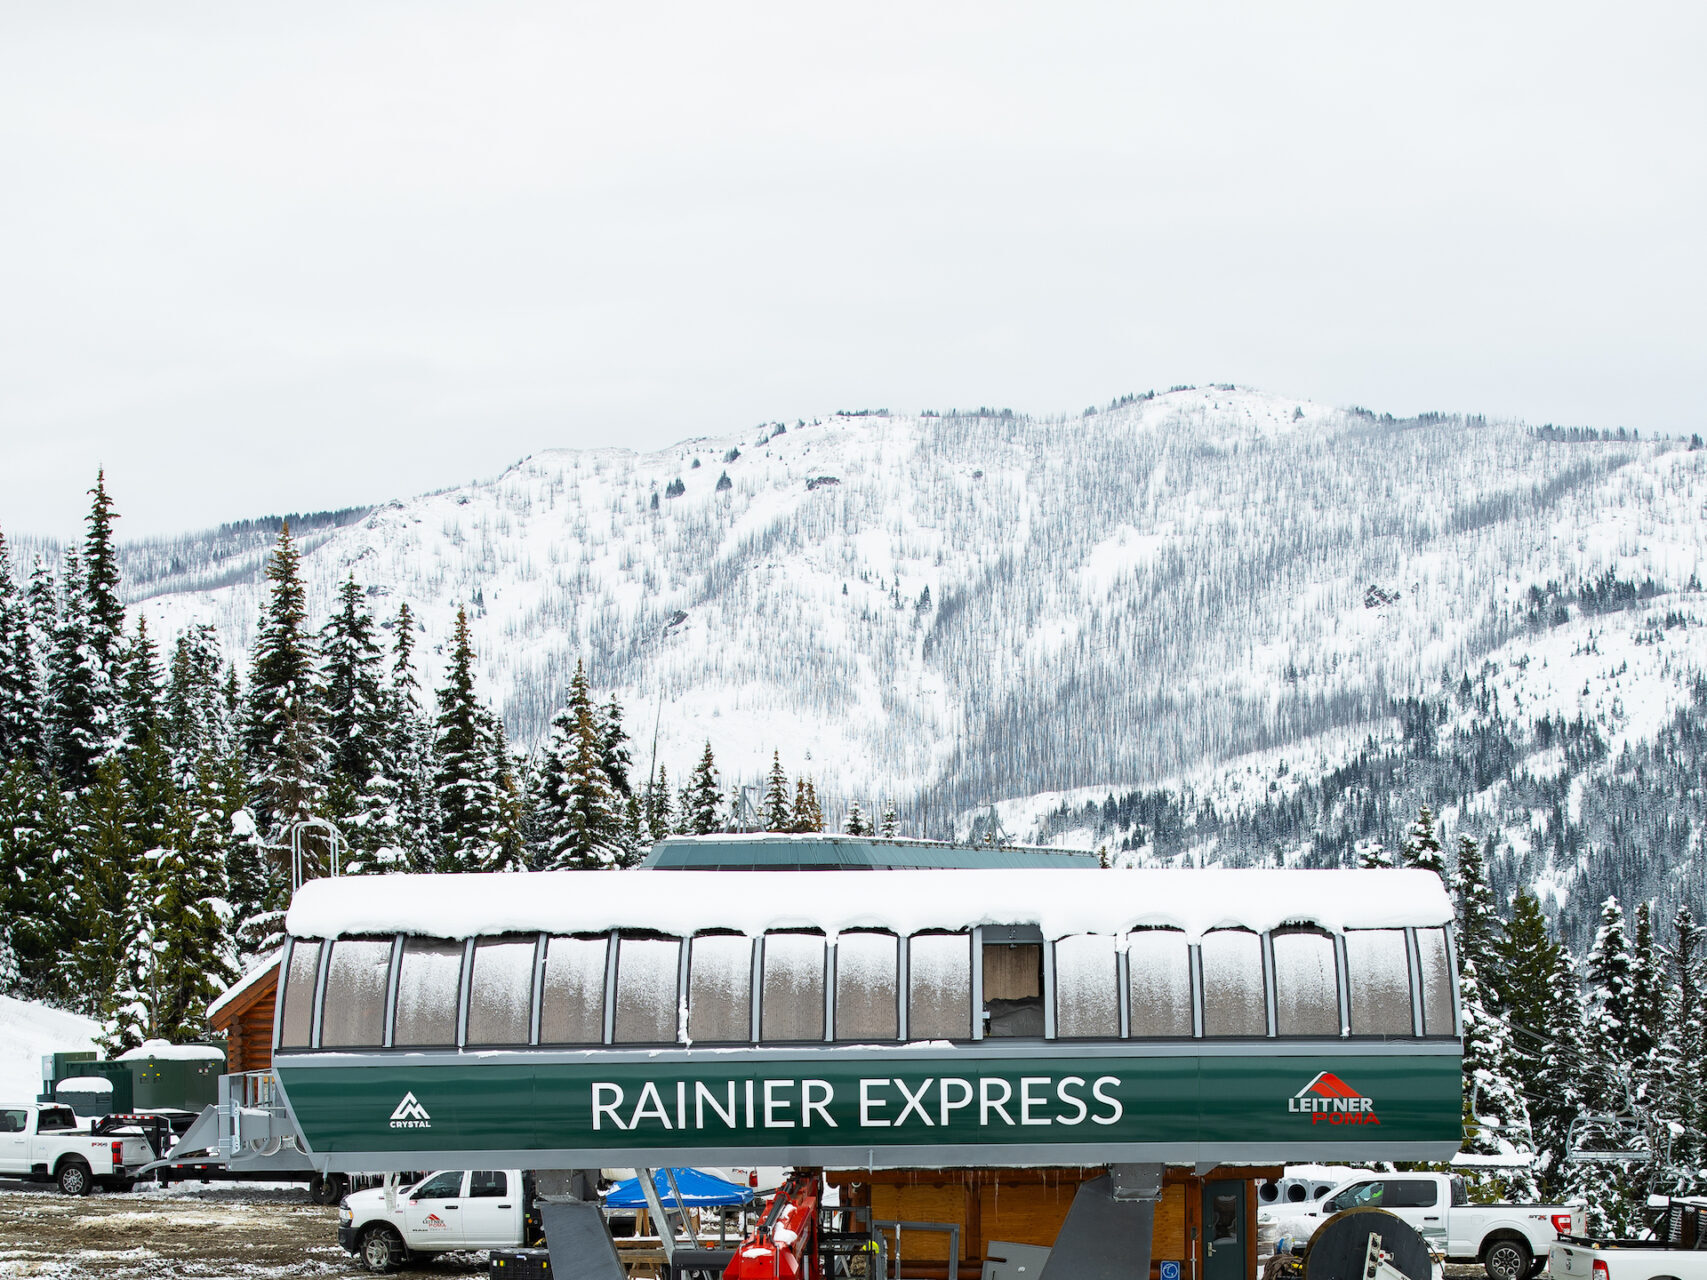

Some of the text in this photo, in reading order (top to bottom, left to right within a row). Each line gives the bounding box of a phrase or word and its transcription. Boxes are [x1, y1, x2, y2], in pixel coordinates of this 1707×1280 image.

[591, 1076, 1124, 1131] RAINIER EXPRESS
[1288, 1098, 1373, 1112] LEITNER
[390, 1120, 431, 1128] CRYSTAL
[1312, 1112, 1380, 1125] POMA
